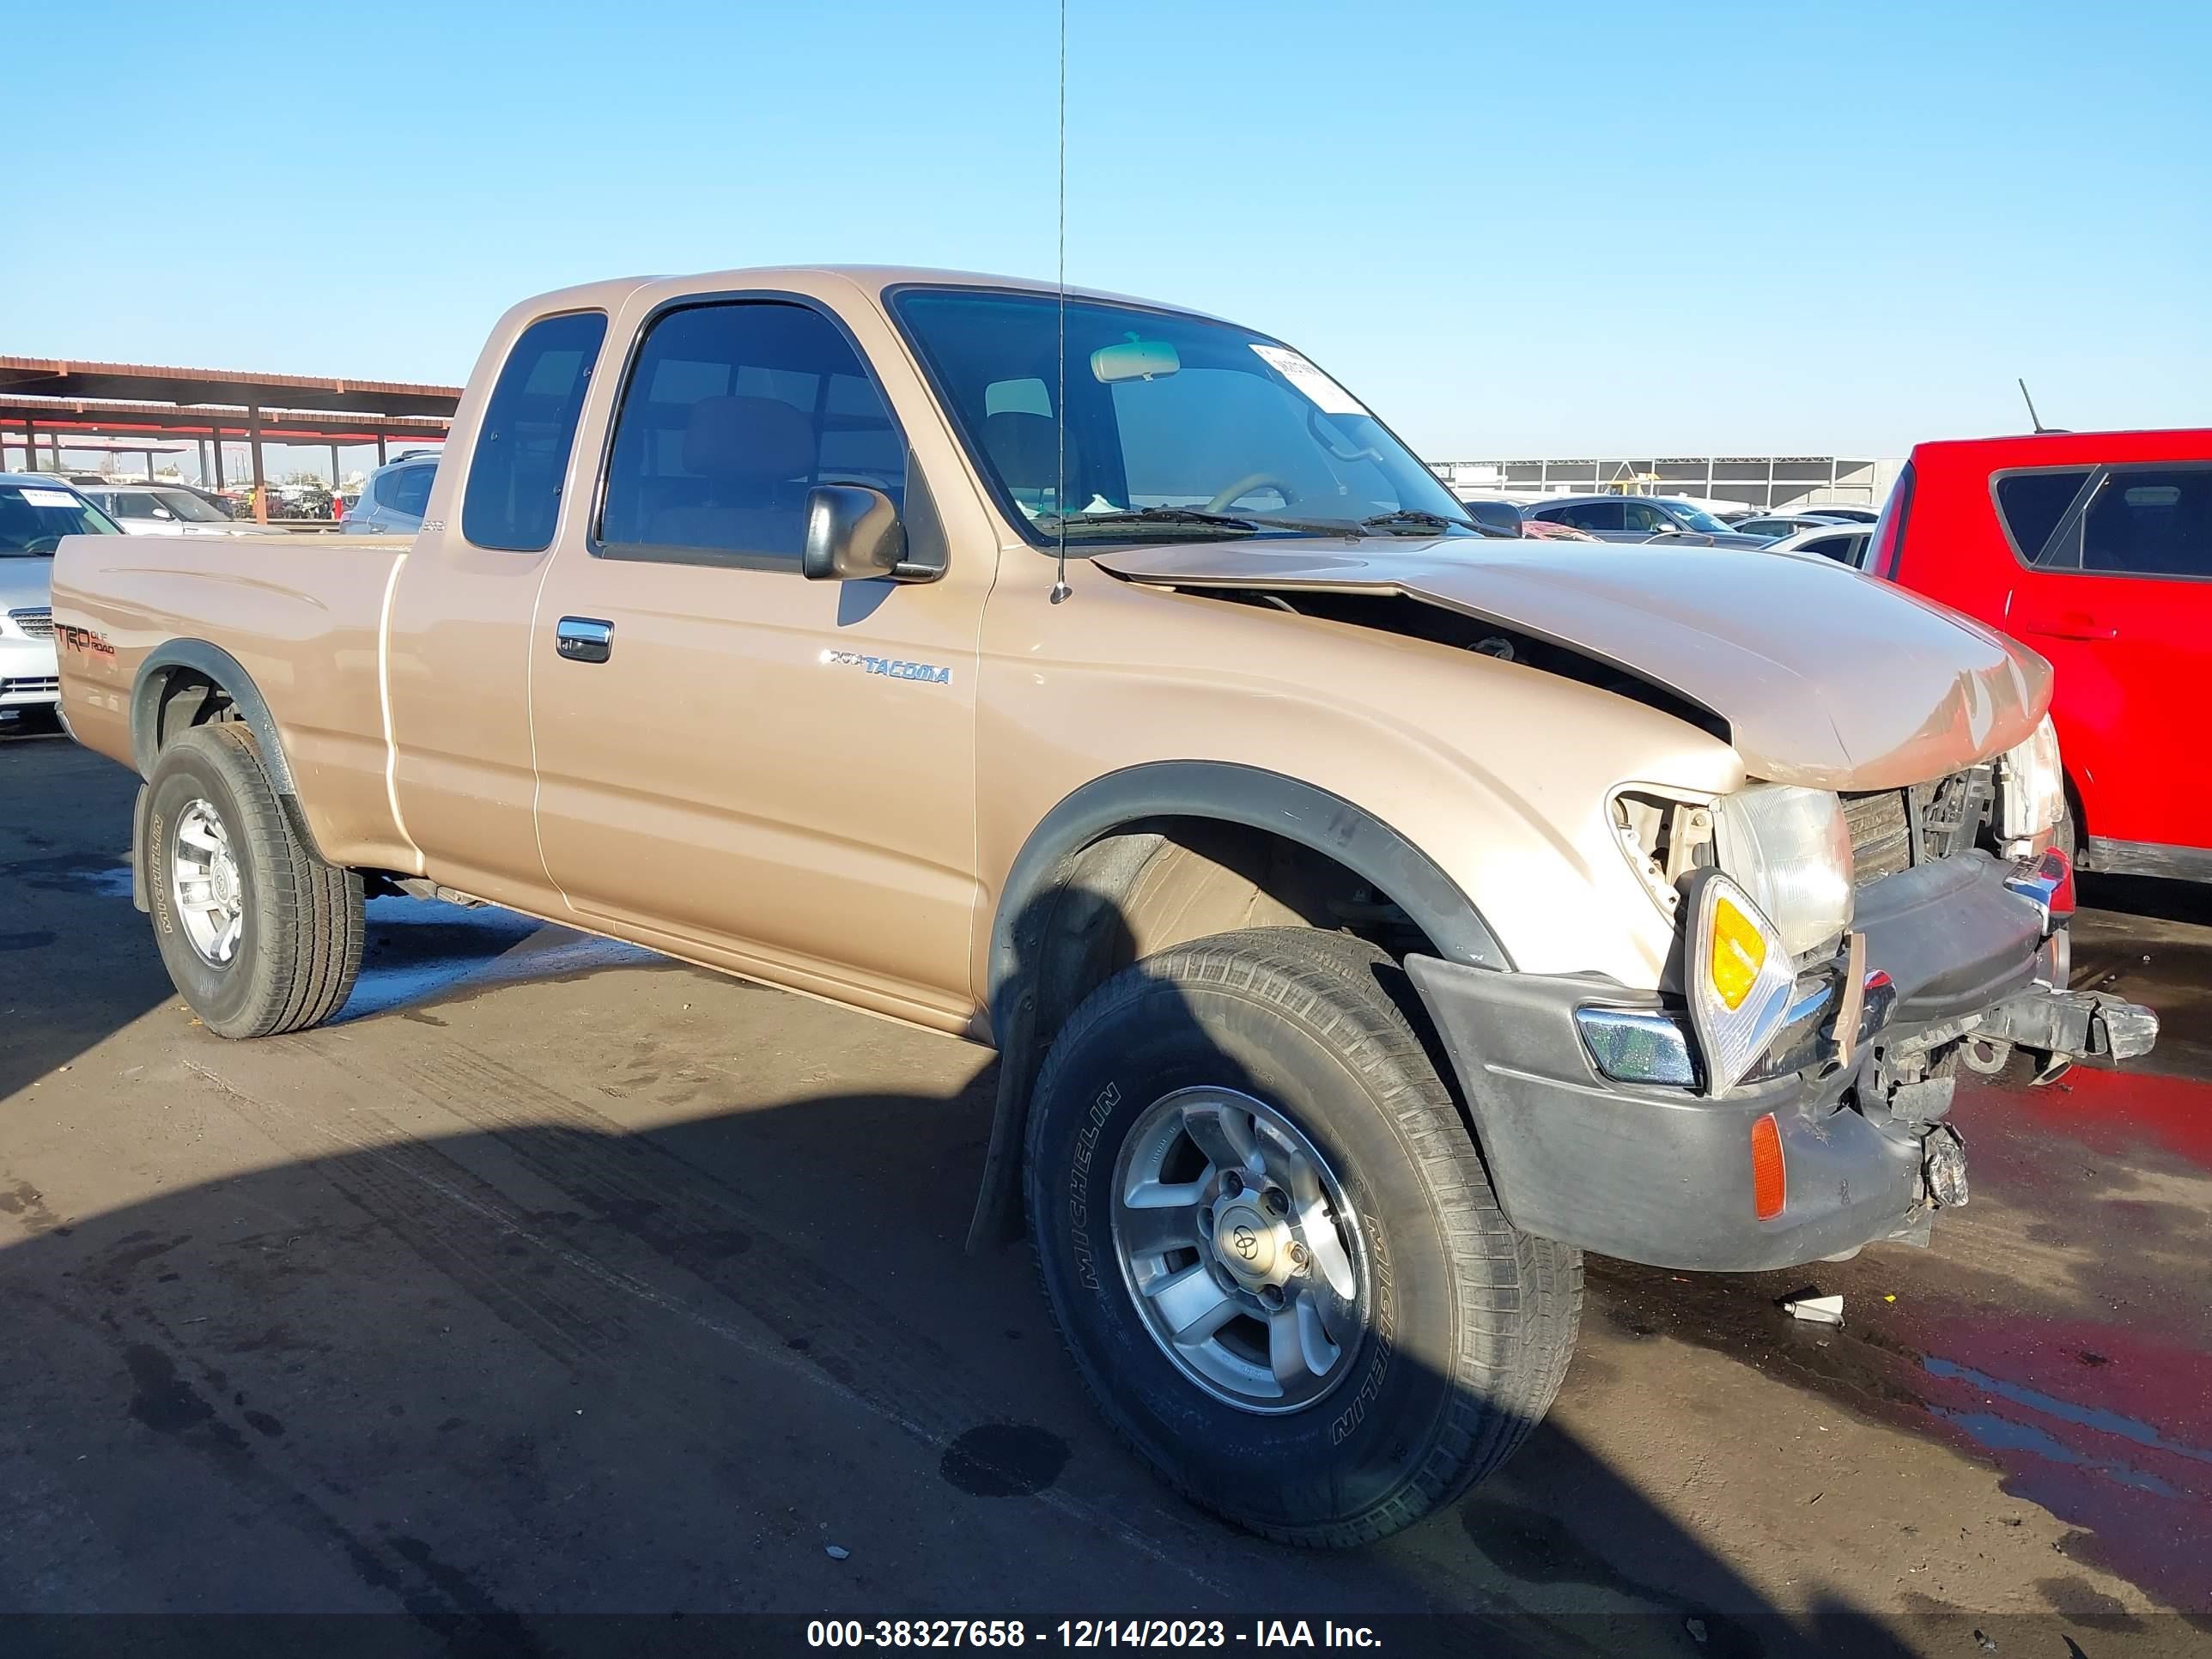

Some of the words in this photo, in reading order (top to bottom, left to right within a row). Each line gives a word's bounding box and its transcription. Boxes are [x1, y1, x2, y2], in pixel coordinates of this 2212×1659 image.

[55, 623, 90, 652] TRD
[91, 641, 115, 654] ROAD
[865, 657, 951, 684] TACOMA
[149, 813, 173, 934] MICHELIN
[1069, 1080, 1122, 1291] MICHELIN
[1332, 1213, 1395, 1446] MICHELIN
